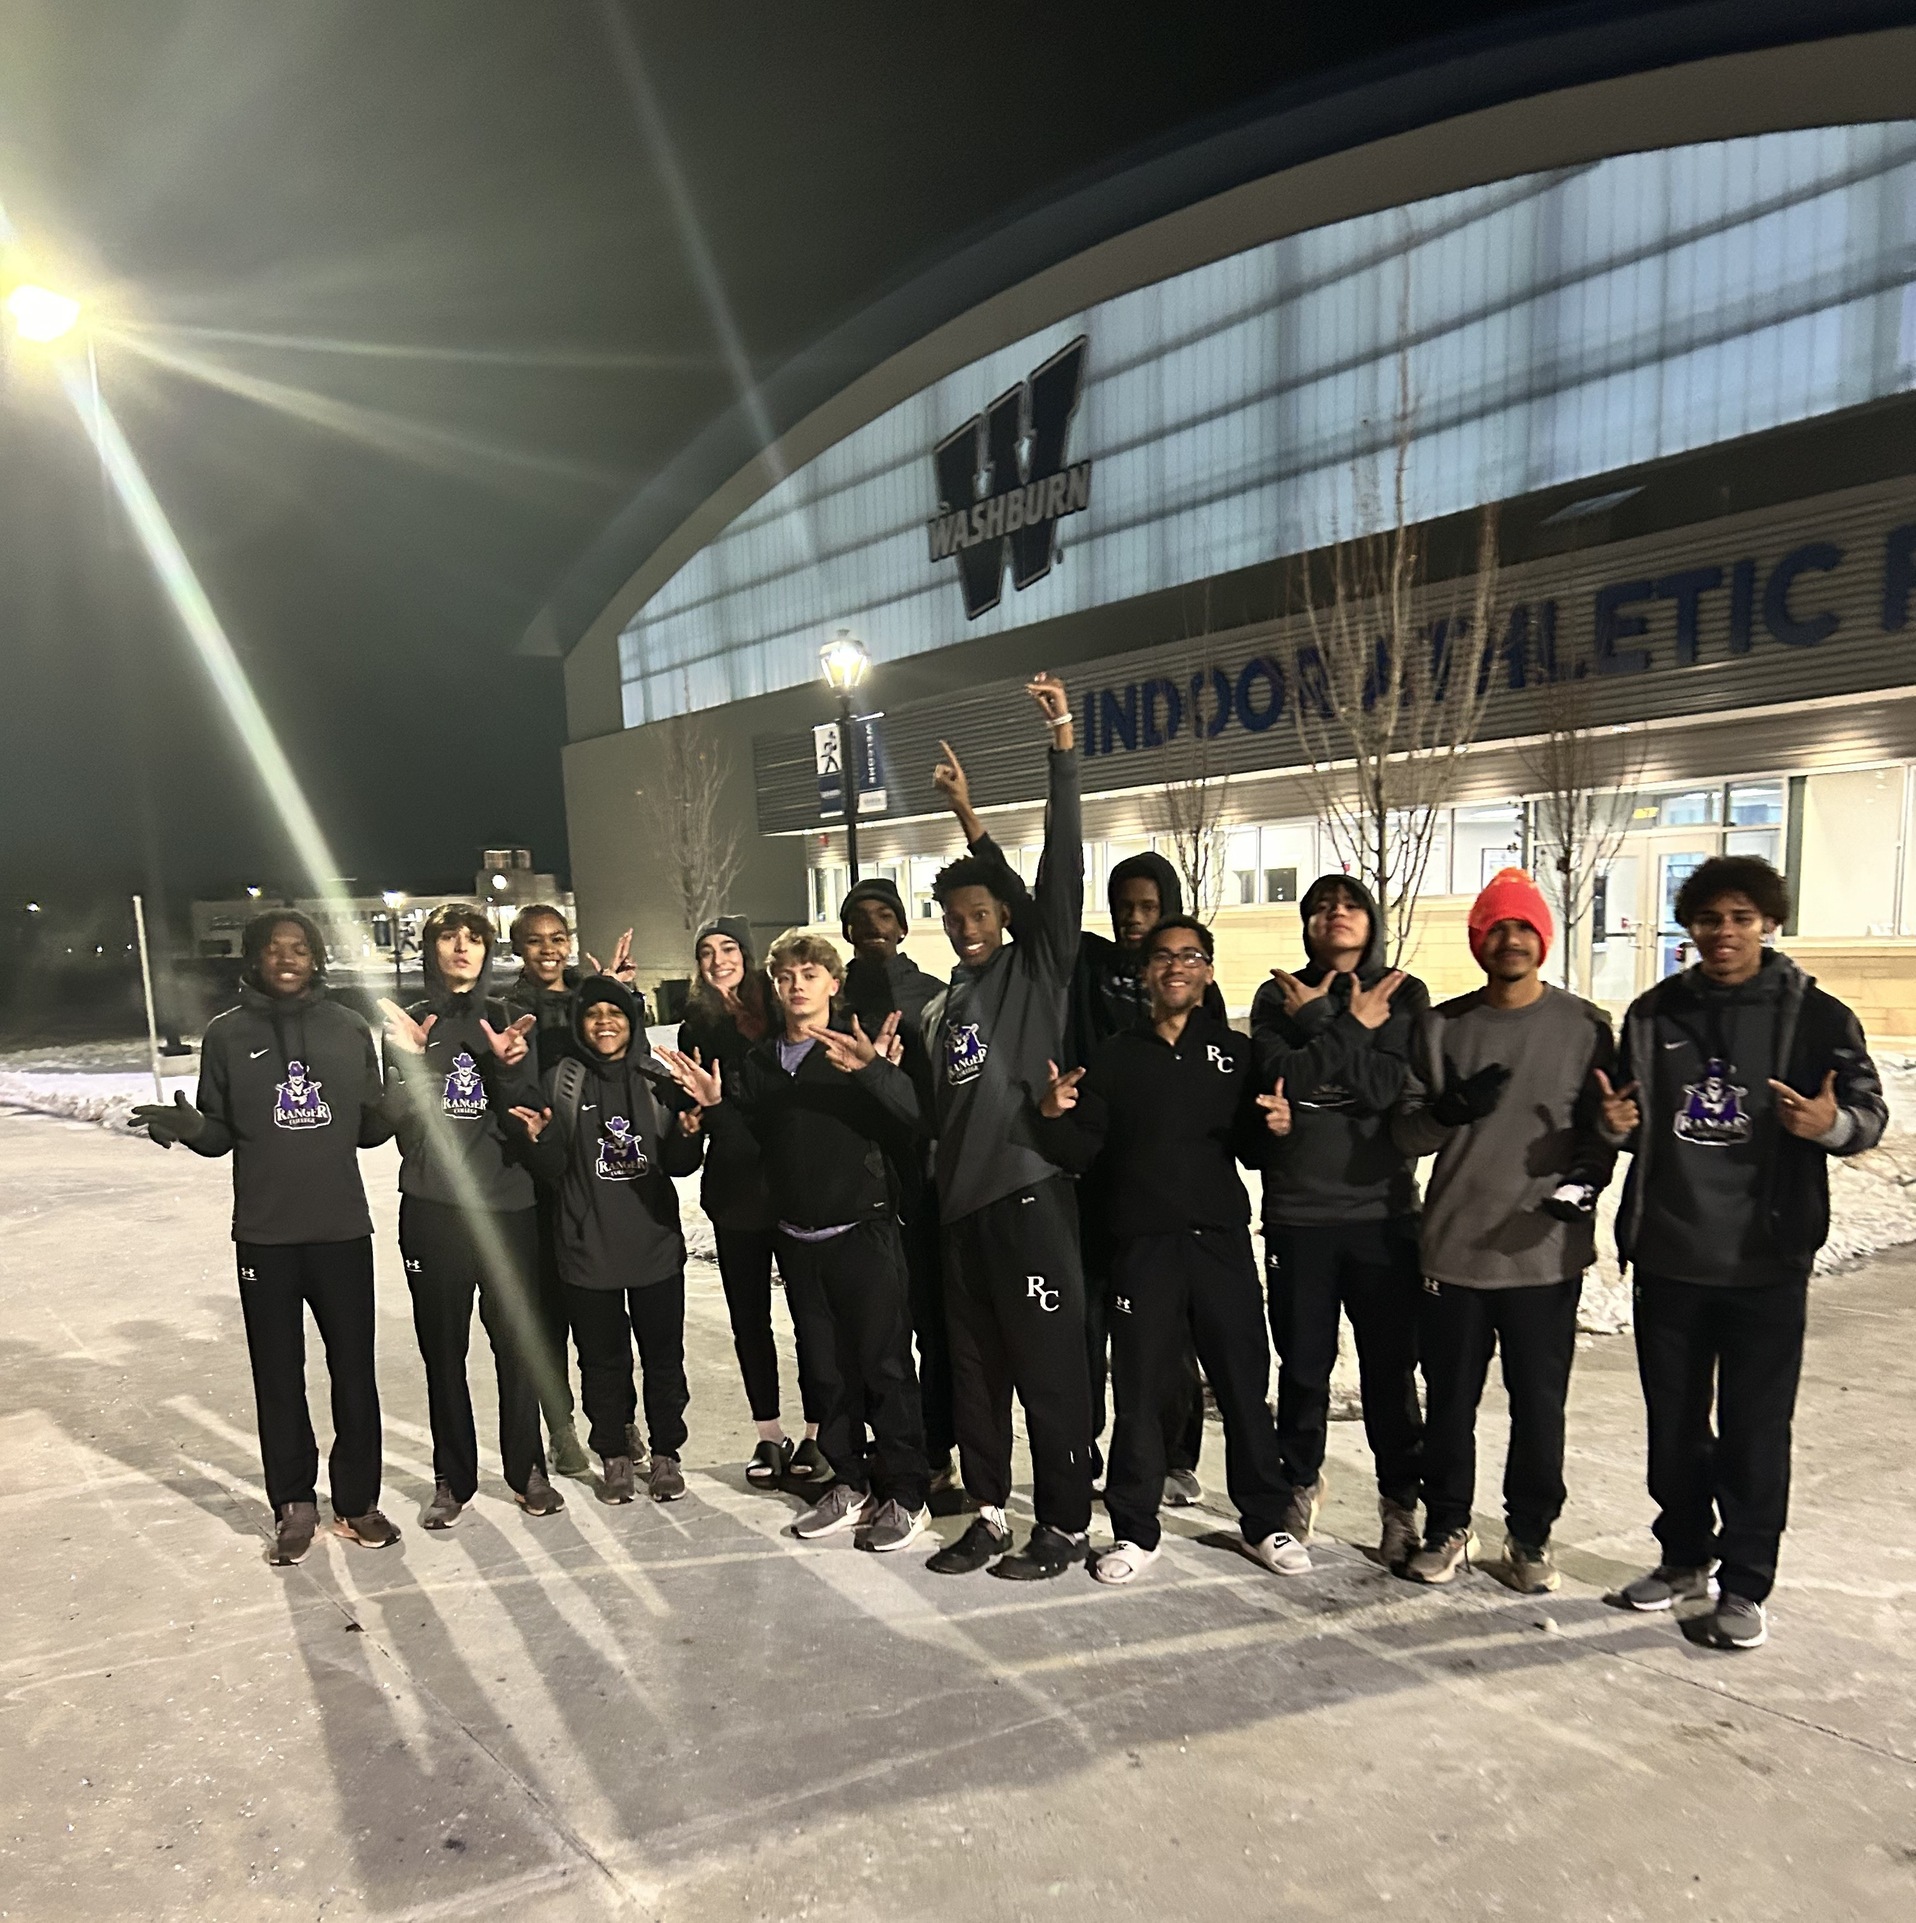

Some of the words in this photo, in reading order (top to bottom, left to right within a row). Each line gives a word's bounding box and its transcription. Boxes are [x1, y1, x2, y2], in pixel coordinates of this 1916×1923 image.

[926, 458, 1093, 564] WASHBURN
[1083, 645, 1339, 757] INDOOR
[947, 1048, 987, 1080] RANGER
[1206, 1044, 1235, 1074] RC
[276, 1104, 329, 1122] RANGER
[442, 1097, 488, 1111] RANGER
[598, 1157, 647, 1174] RANGER
[1025, 1275, 1060, 1312] RC
